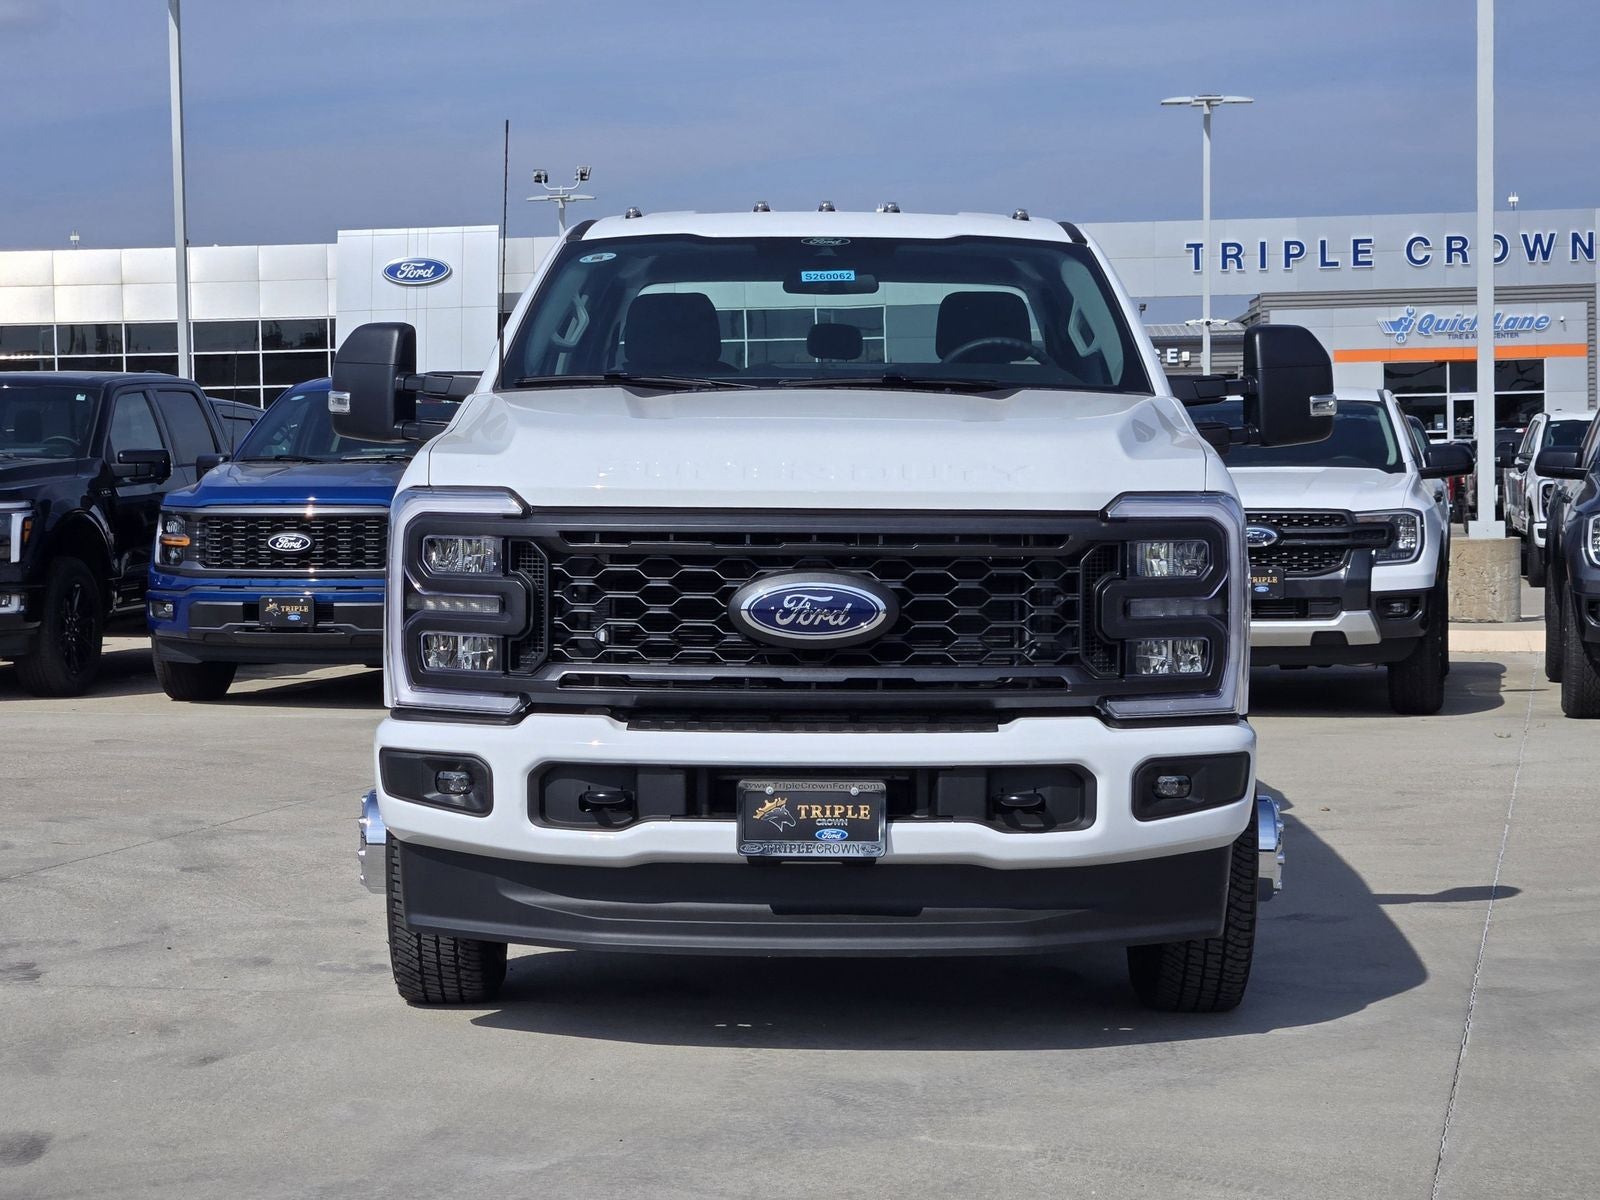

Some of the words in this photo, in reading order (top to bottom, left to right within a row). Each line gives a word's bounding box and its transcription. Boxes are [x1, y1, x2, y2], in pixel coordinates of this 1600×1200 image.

[1185, 236, 1375, 273] TRIPLE
[396, 262, 435, 278] Ford
[804, 272, 853, 281] S260062
[1493, 311, 1552, 332] Lane
[1447, 332, 1464, 340] TIRE
[275, 536, 303, 549] Ford
[280, 605, 309, 613] TRIPLE
[775, 593, 853, 626] Ford
[744, 782, 881, 790] wwwTripleCrownFord.com
[797, 804, 871, 820] TRIPLE
[815, 818, 848, 826] CROWN
[763, 843, 813, 854] TRIPLE
[816, 843, 860, 855] CROWN
